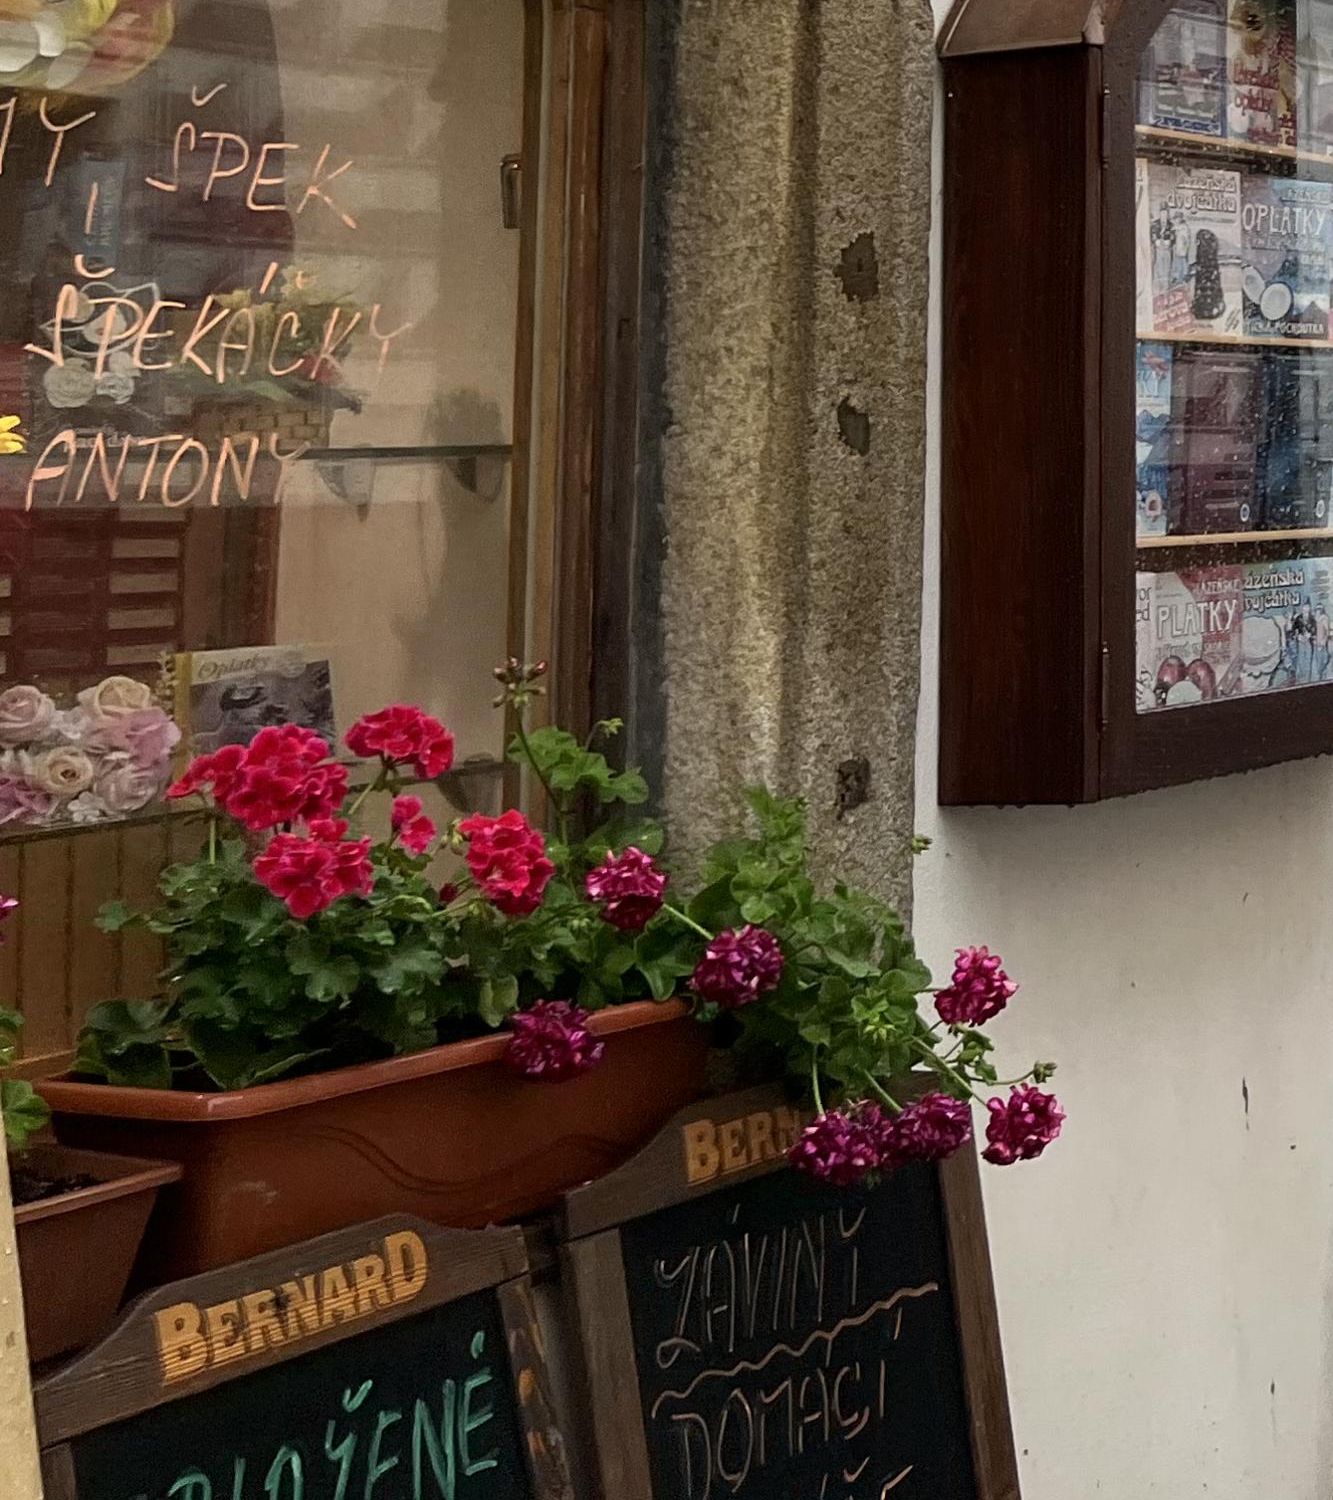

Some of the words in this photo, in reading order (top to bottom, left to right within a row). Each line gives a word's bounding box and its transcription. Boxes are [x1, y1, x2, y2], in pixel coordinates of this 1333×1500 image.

[0, 97, 96, 186] Y
[145, 83, 357, 230] ŠPEK
[24, 254, 413, 384] ŠPEKÁČKY
[25, 430, 311, 512] ANTONY
[1156, 599, 1238, 641] PLATKY
[154, 1230, 430, 1387] BERNARD
